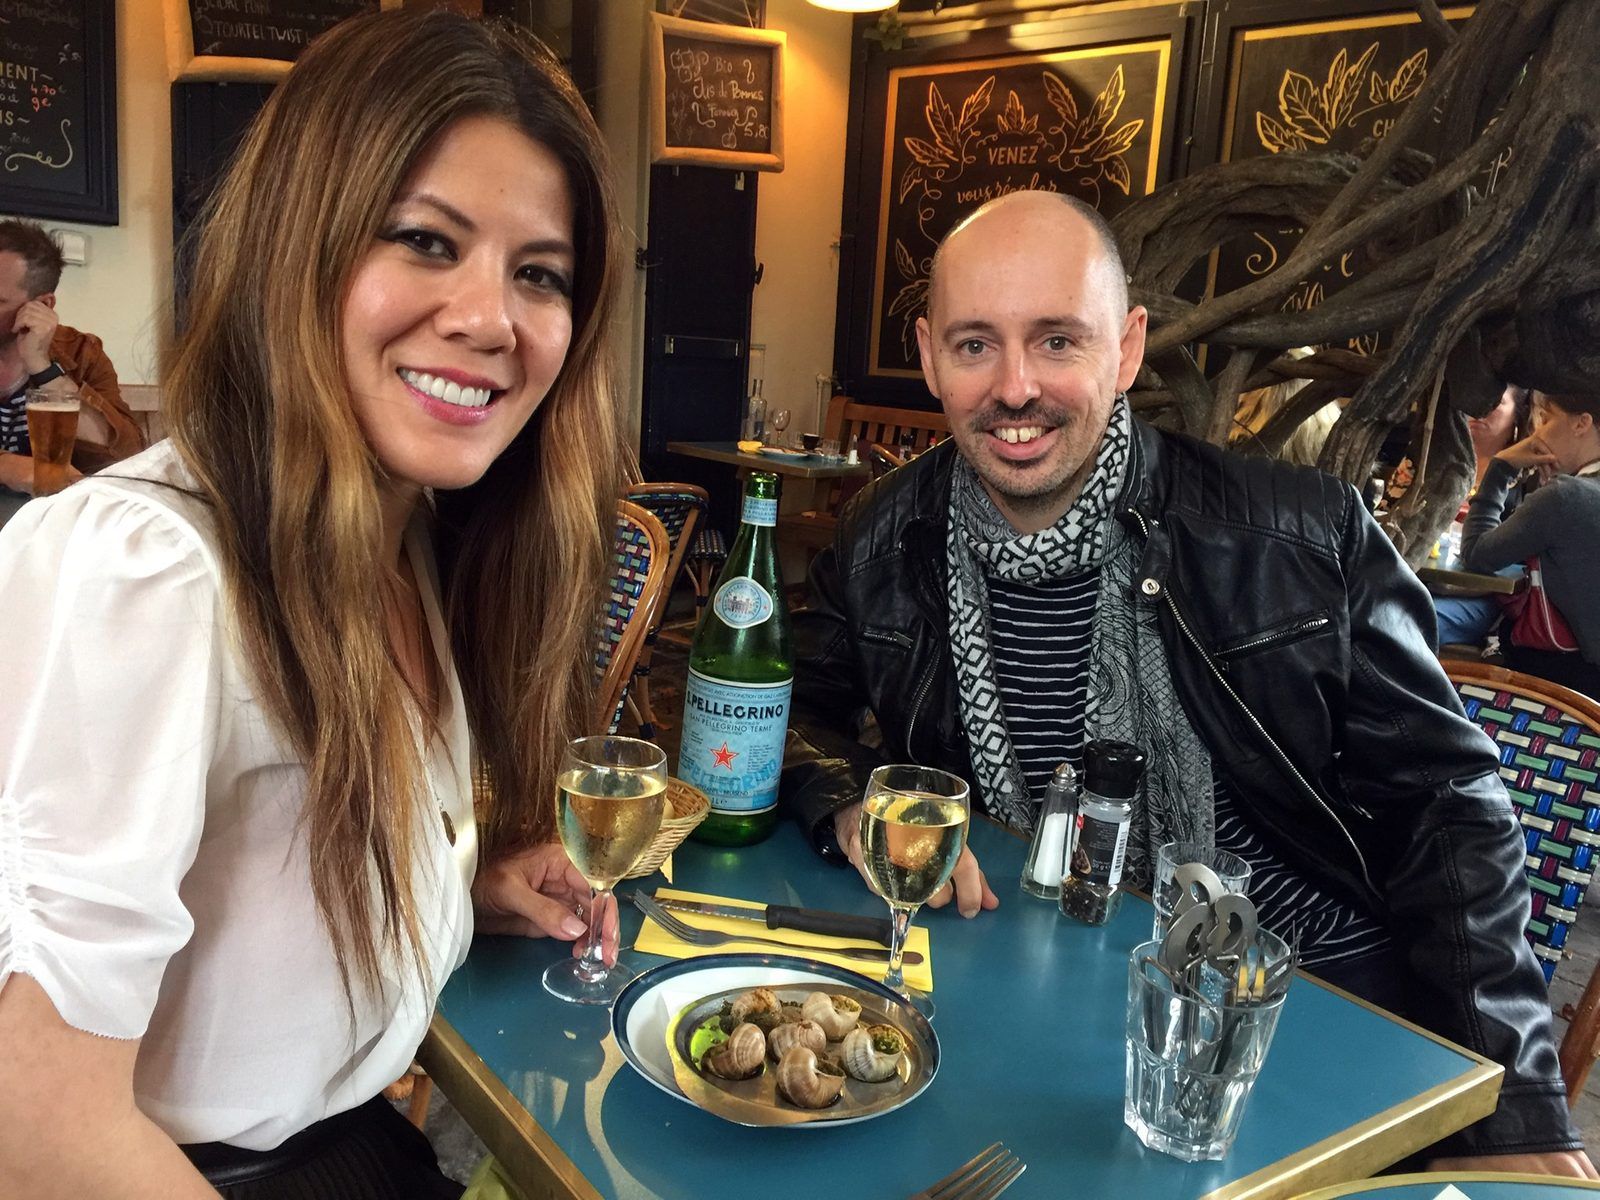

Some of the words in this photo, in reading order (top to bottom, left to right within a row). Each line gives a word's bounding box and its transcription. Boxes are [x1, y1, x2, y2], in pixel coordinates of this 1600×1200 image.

[267, 26, 302, 44] TWIST
[712, 57, 733, 73] Bio
[988, 145, 1039, 165] VENEZ
[957, 185, 992, 204] vous
[701, 716, 748, 733] PELLEGRINO
[751, 725, 772, 733] TERME
